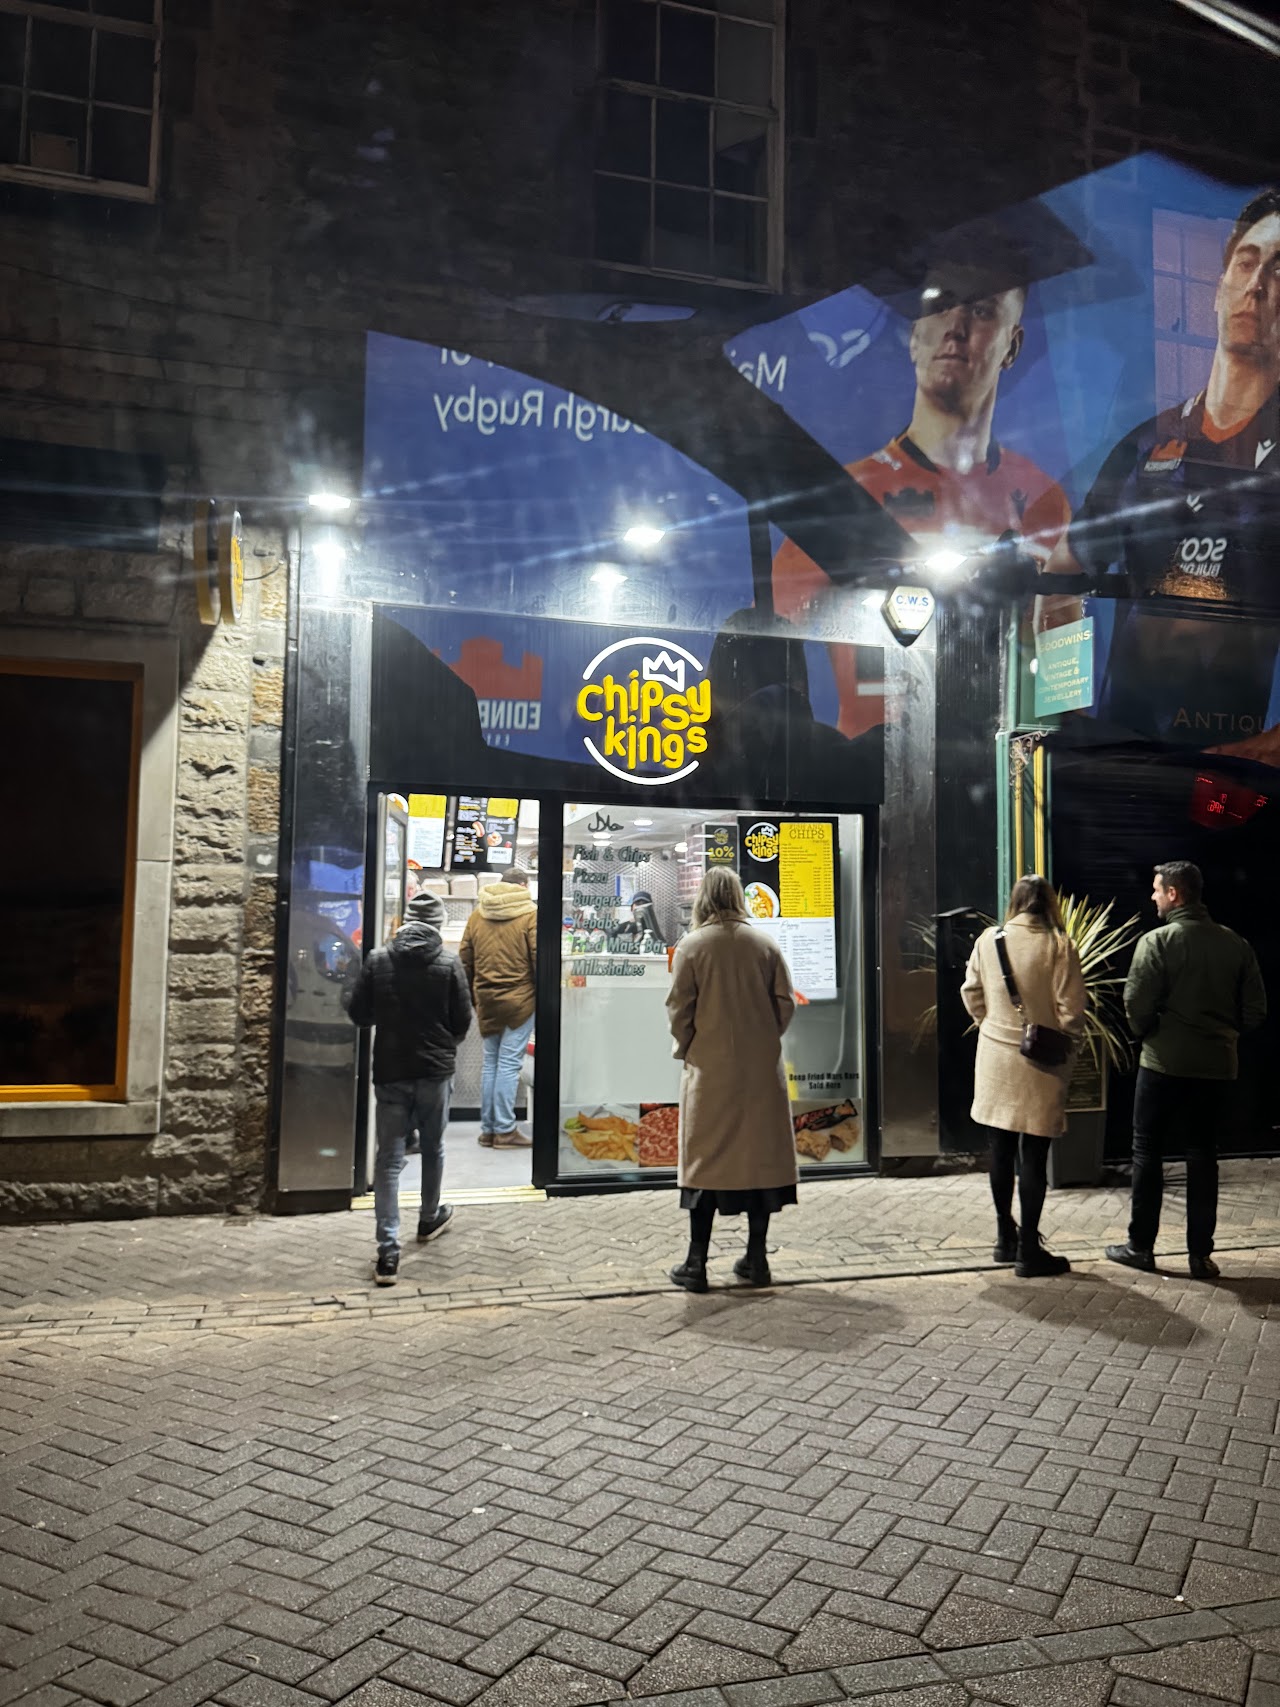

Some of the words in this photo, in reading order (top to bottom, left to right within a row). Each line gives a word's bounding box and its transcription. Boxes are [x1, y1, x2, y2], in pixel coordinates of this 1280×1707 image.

[576, 669, 712, 731] chipsy
[604, 715, 709, 770] kings
[789, 829, 825, 840] CHIPS
[573, 845, 600, 861] Fish
[603, 847, 614, 861] &
[618, 846, 652, 867] Chips
[707, 845, 735, 858] 10%
[573, 868, 609, 883] Pizza
[573, 891, 623, 911] Burgers
[573, 914, 621, 930] Kebabs
[606, 938, 640, 954] Mars
[572, 959, 647, 976] Milkshakes
[807, 1072, 825, 1080] Fried
[809, 1082, 824, 1090] Sold
